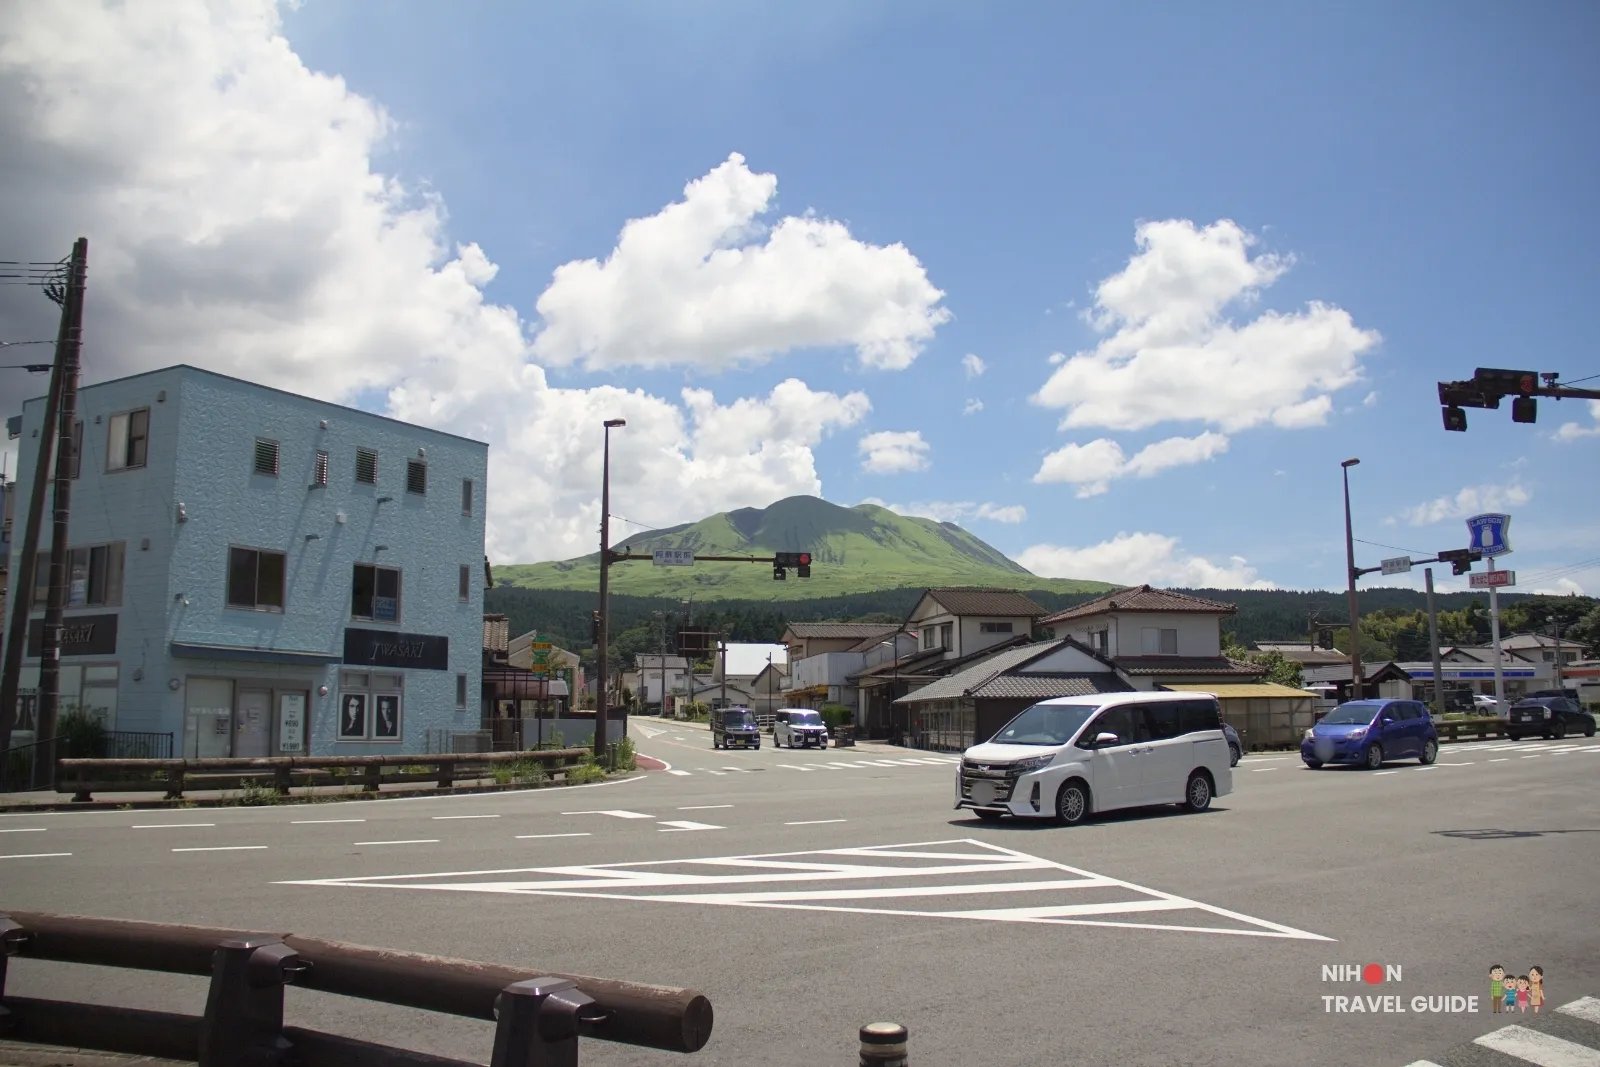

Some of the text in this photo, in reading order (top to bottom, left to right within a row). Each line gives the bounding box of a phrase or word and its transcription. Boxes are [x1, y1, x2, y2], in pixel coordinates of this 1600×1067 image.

[1471, 517, 1502, 527] LAWSON
[61, 624, 94, 643] ASAKI
[370, 641, 426, 660] IWASAKI
